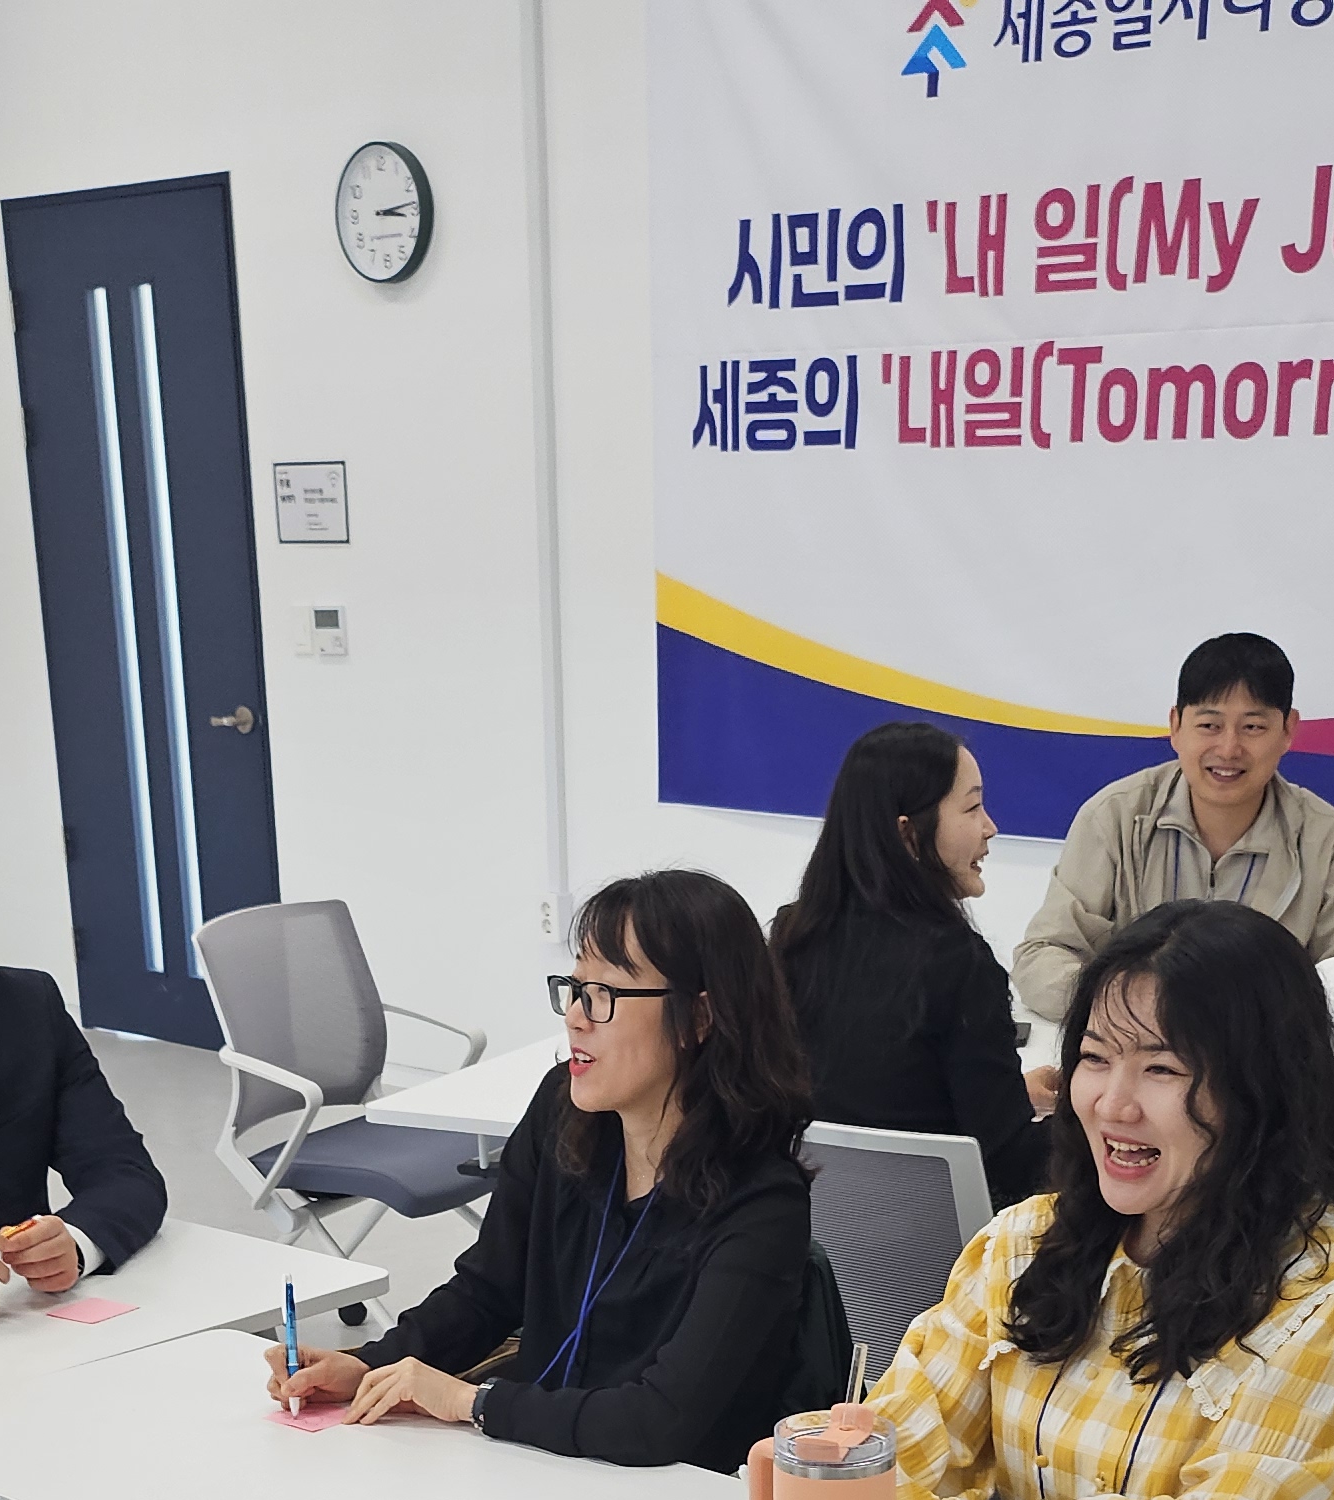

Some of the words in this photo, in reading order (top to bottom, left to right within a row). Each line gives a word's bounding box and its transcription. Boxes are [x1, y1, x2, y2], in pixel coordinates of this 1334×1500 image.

[727, 203, 905, 309] 시민의
[926, 193, 1008, 298] '내
[1034, 176, 1260, 293] 일(My
[692, 354, 859, 452] 세종의
